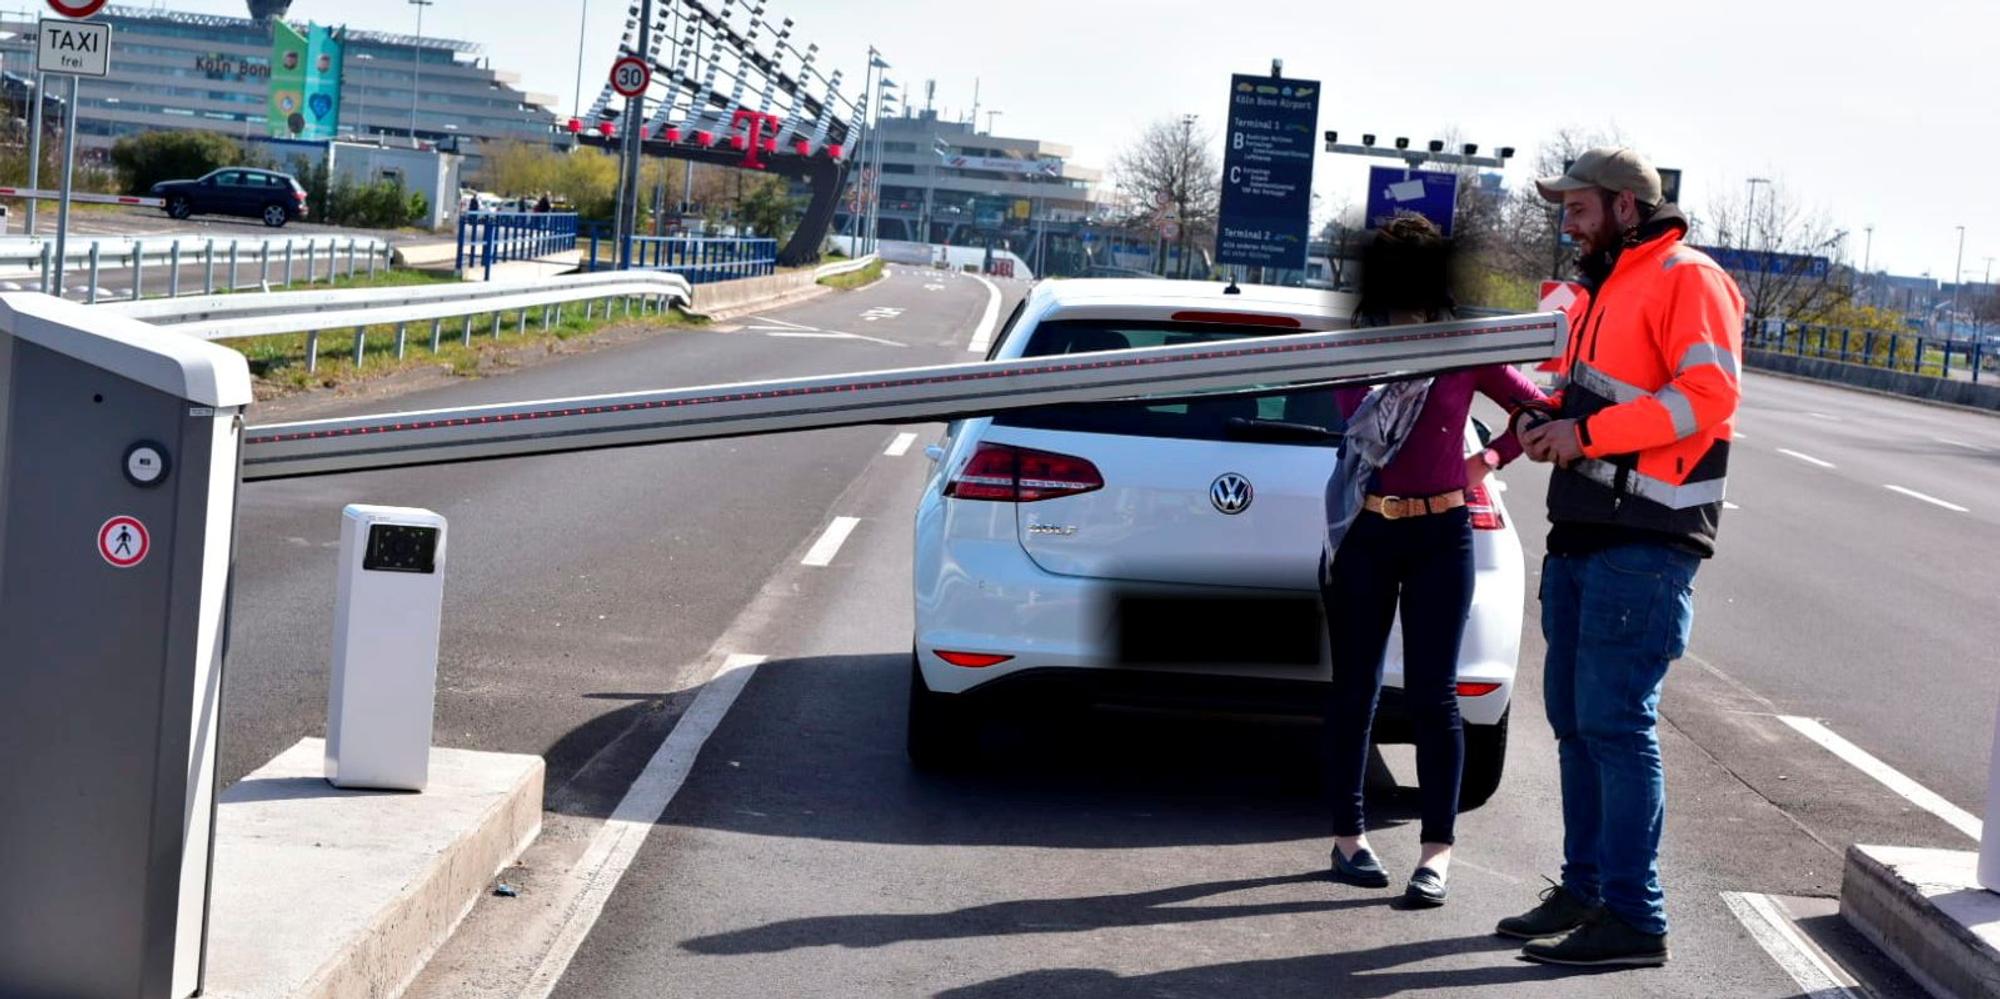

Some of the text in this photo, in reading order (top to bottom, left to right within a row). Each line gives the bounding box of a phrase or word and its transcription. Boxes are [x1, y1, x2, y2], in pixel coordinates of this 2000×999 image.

[48, 28, 98, 53] TAXI
[61, 54, 83, 68] frei
[618, 67, 642, 87] 30
[1235, 95, 1312, 110] Köln Bonn Airport
[1234, 117, 1280, 130] Terminal 1
[732, 109, 779, 170] T
[1233, 131, 1244, 149] B
[1230, 166, 1241, 184] C
[1224, 227, 1271, 240] Terminal 2
